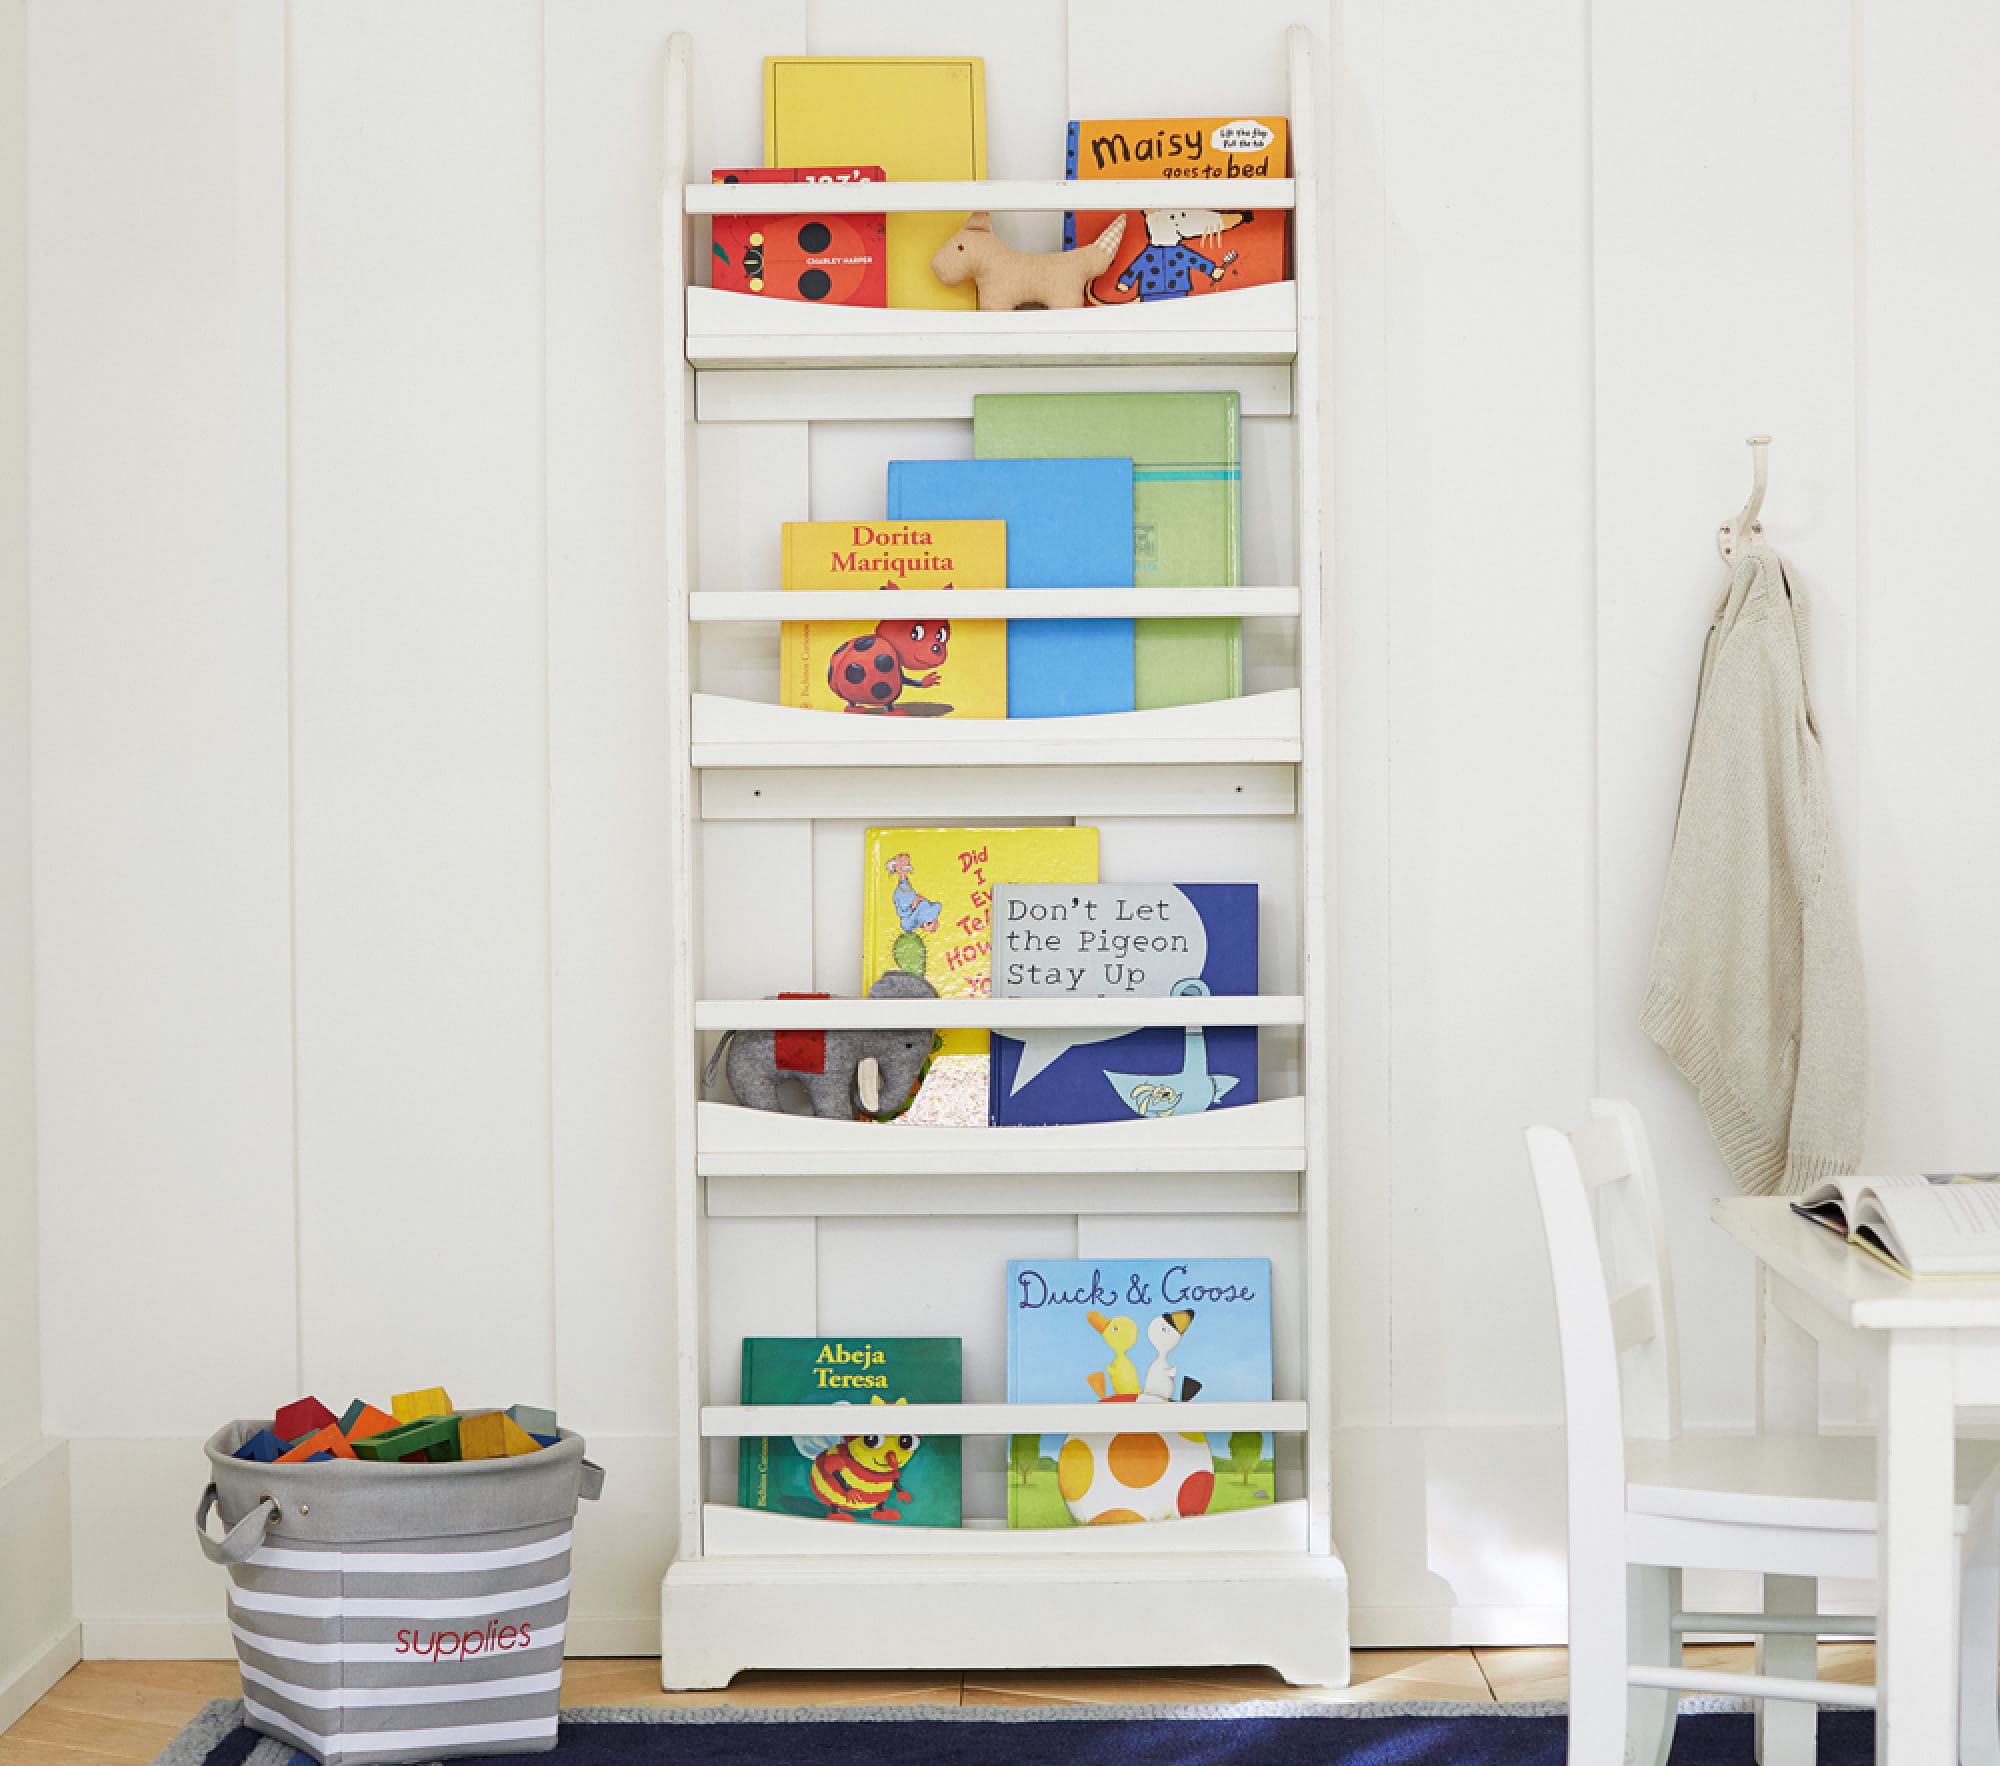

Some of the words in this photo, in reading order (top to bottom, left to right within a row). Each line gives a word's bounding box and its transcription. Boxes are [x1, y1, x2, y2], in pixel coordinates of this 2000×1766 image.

[1162, 166, 1199, 179] goes
[1202, 163, 1223, 178] to
[1227, 153, 1269, 178] bed
[852, 525, 933, 546] Dorita
[831, 551, 955, 578] Mariquita
[957, 846, 989, 873] Did
[955, 908, 991, 935] Tel
[1006, 897, 1097, 921] Don't
[1115, 899, 1170, 921] Let
[1006, 930, 1062, 952] the
[1077, 929, 1189, 958] Pigeon
[1007, 963, 1087, 991] Stay
[1104, 963, 1146, 991] Up
[1018, 1268, 1118, 1309] Duck
[1126, 1273, 1152, 1305] &
[1161, 1264, 1256, 1305] Goose
[815, 1343, 887, 1370] Abeja
[812, 1367, 889, 1388] Teresa
[395, 1619, 531, 1663] supplies
